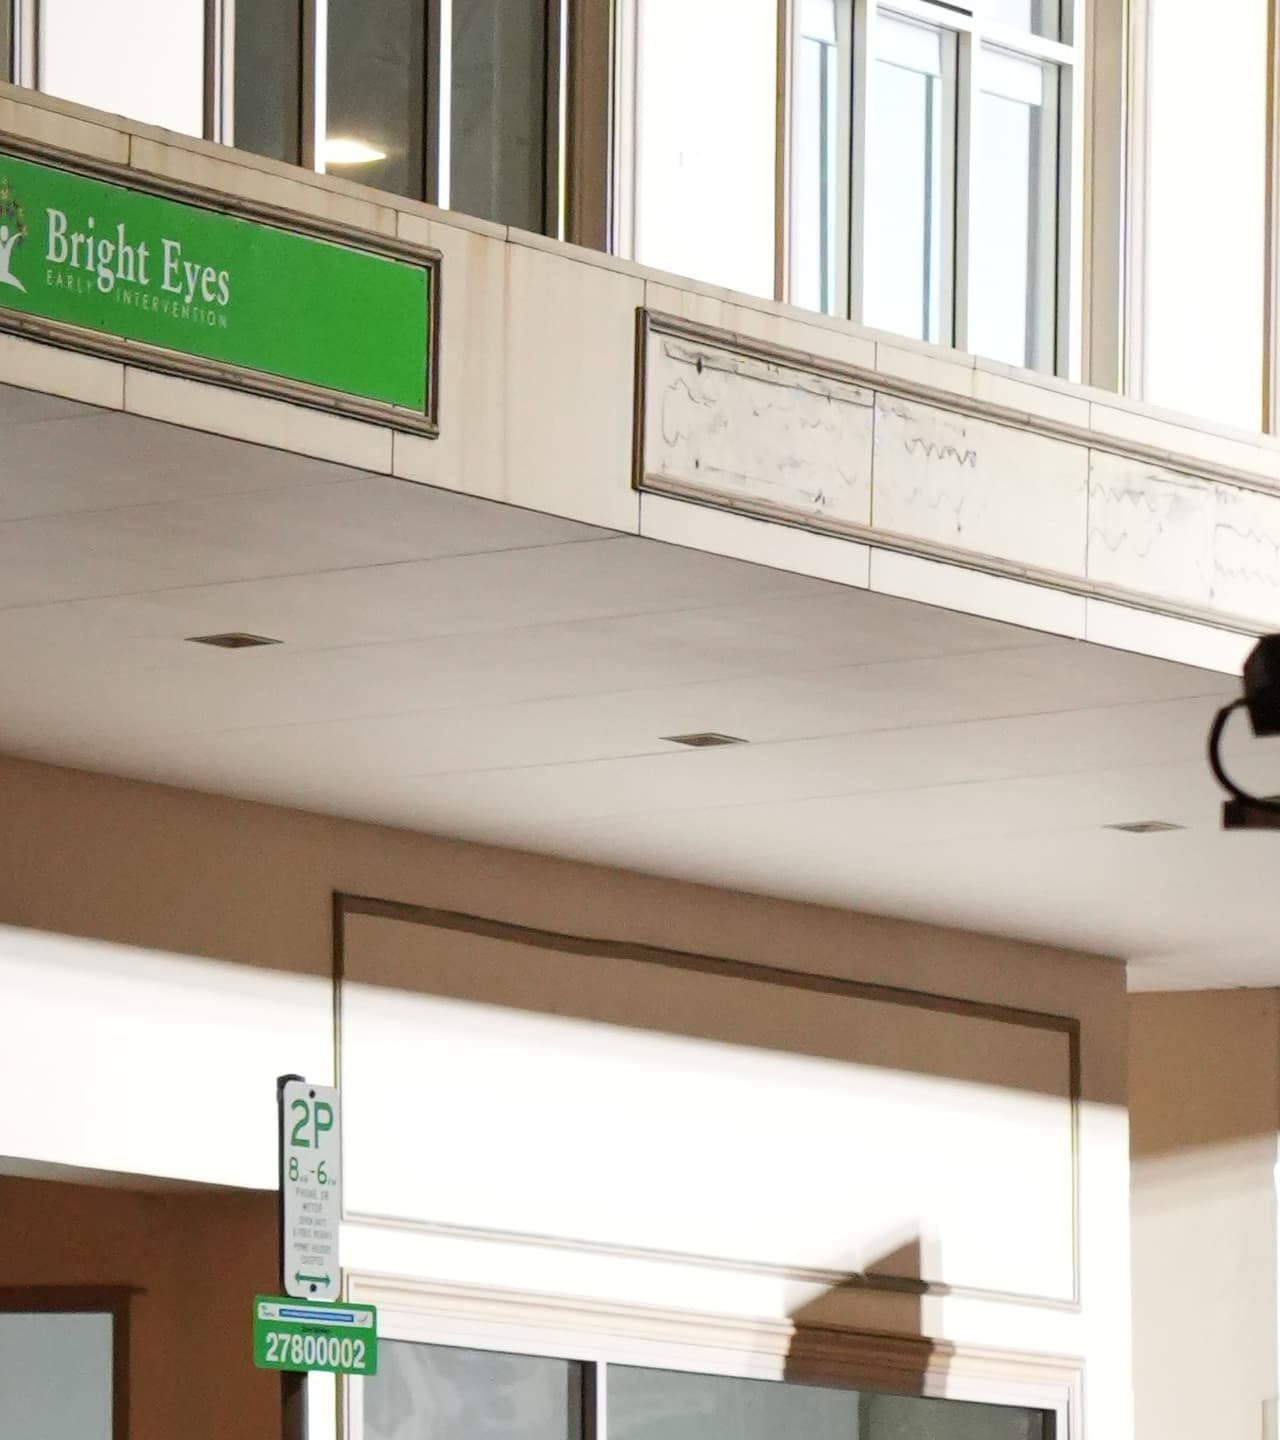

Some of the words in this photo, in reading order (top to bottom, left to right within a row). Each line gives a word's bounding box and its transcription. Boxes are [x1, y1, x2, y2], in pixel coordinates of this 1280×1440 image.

[45, 208, 150, 294] Bright
[161, 237, 230, 306] Eyes
[46, 269, 92, 295] EARLY
[116, 287, 227, 329] INTERVENTION
[290, 1098, 335, 1149] 2P
[265, 1331, 366, 1370] 27800002
